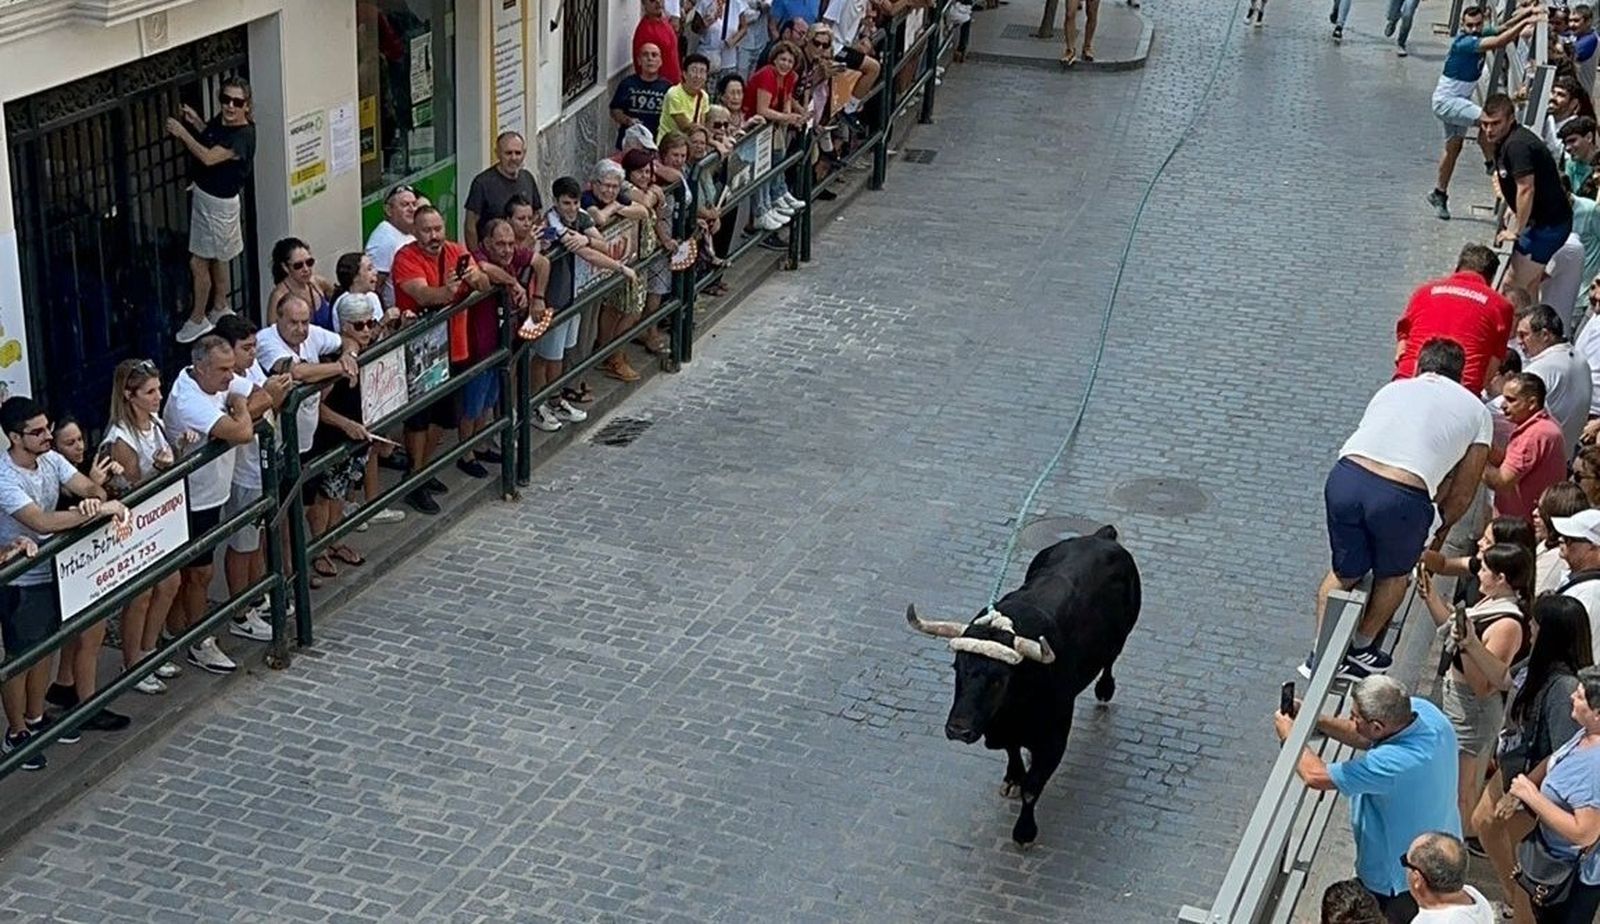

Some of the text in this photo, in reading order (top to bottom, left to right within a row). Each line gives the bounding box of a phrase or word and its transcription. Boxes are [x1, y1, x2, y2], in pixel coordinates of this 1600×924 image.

[630, 95, 663, 110] 1963
[136, 493, 183, 530] Cruzcampo
[96, 567, 115, 586] 660
[117, 554, 136, 573] 821
[138, 541, 157, 559] 733
